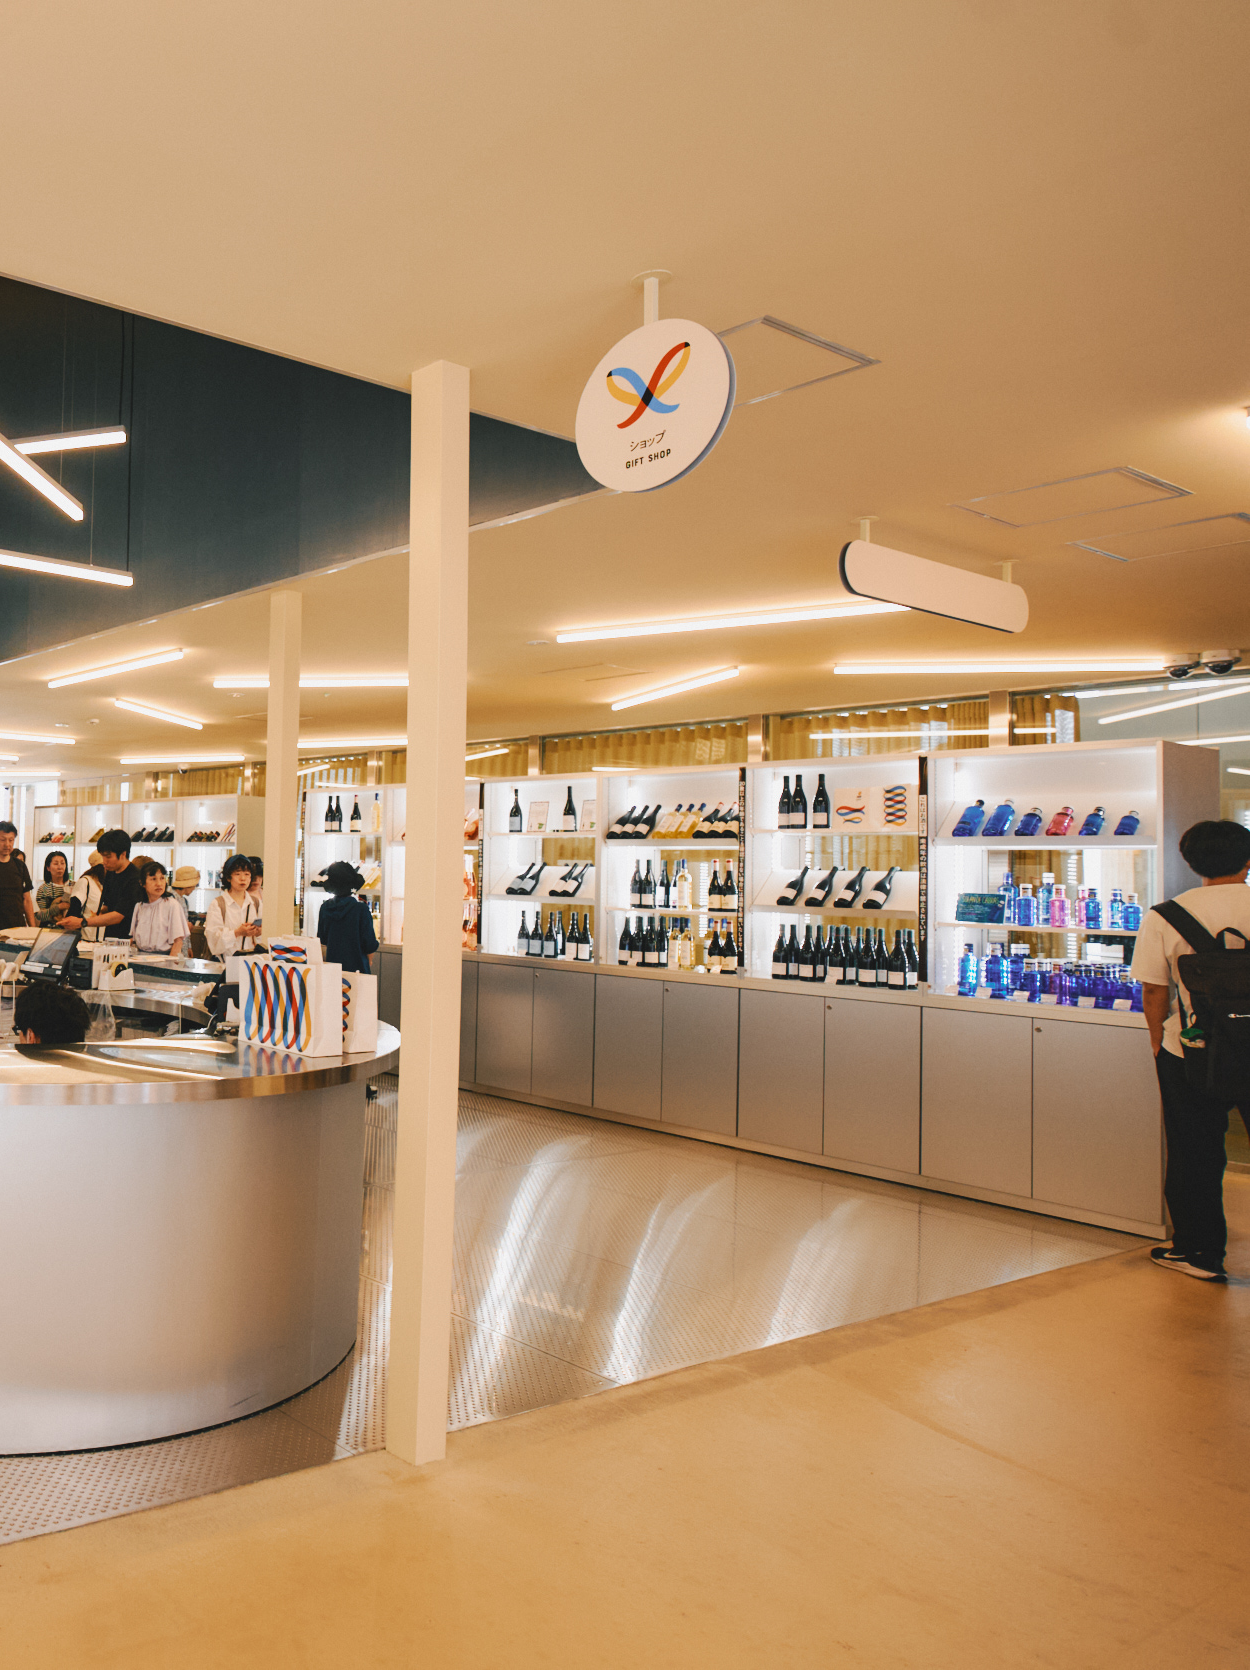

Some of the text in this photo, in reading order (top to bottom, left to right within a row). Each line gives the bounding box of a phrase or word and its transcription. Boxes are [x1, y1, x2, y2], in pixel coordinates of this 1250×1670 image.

[630, 430, 666, 452] ショップ
[625, 448, 671, 469] GIFT SHOP
